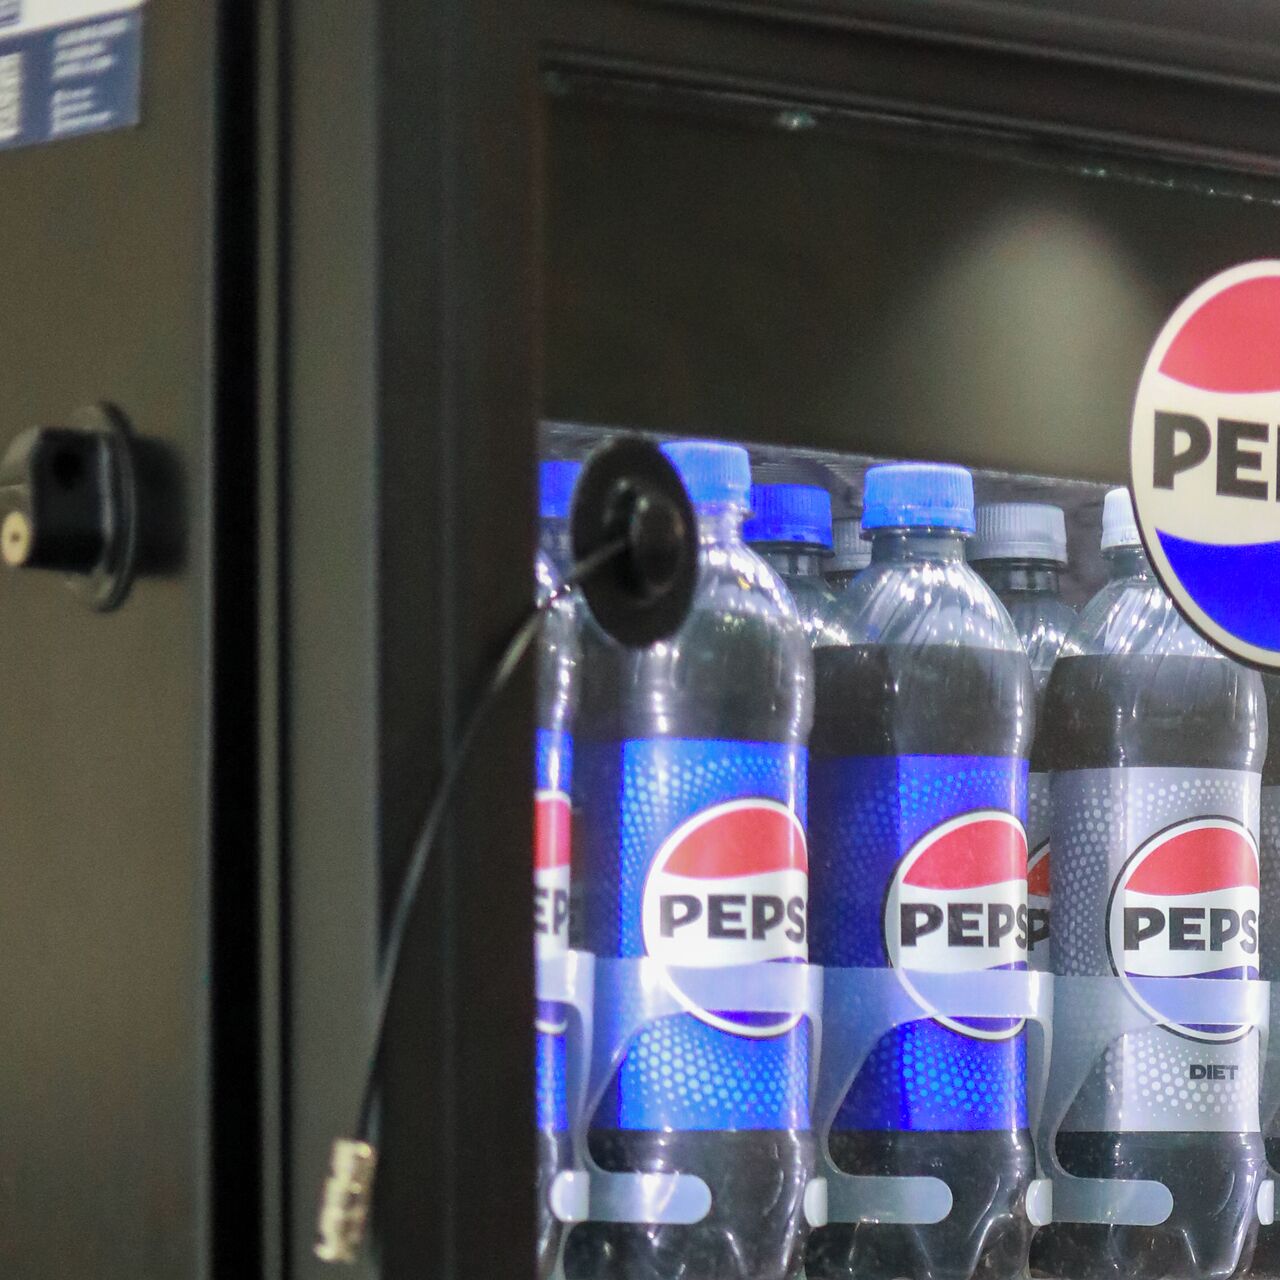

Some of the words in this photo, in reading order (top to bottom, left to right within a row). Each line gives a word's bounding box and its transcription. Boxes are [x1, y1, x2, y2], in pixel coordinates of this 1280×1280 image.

[660, 894, 806, 944] PEPS
[900, 902, 1028, 950] PEPS
[1123, 906, 1258, 954] PEPS
[1189, 1064, 1238, 1080] DIET
